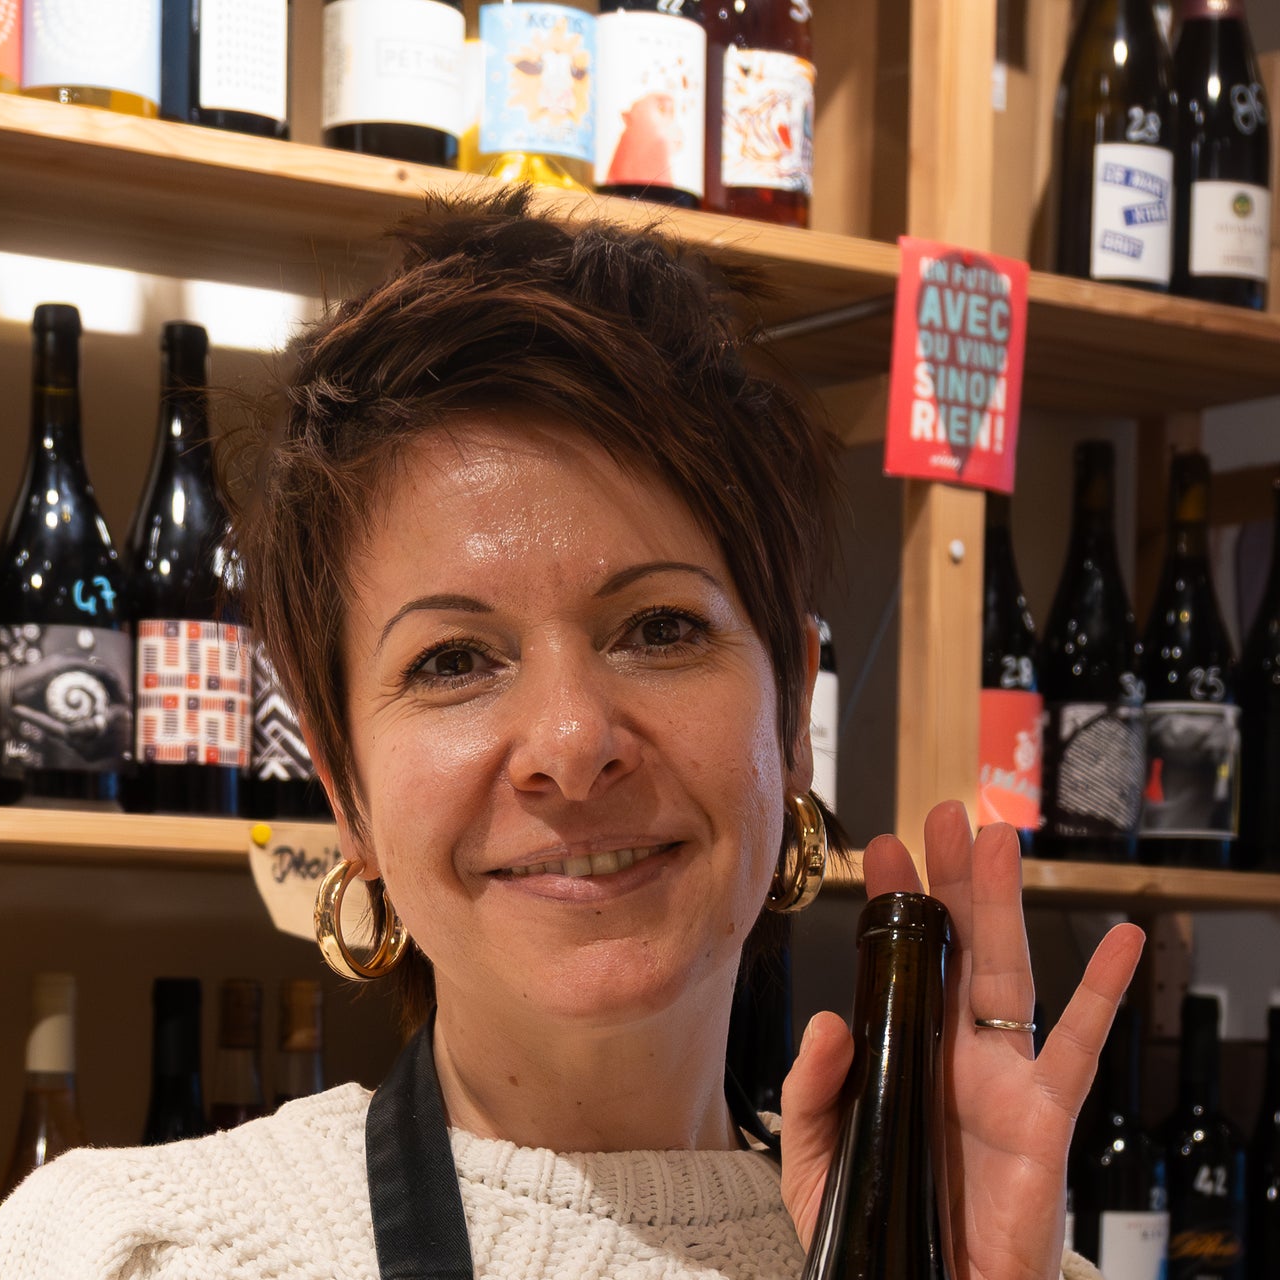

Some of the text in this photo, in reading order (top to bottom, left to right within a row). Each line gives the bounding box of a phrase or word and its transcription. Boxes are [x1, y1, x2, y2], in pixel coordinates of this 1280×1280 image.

[920, 257, 948, 285] UN
[920, 285, 1010, 341] AVEC
[916, 329, 950, 360] DU
[914, 361, 1007, 413] SINON
[910, 399, 1004, 454] RIEN!
